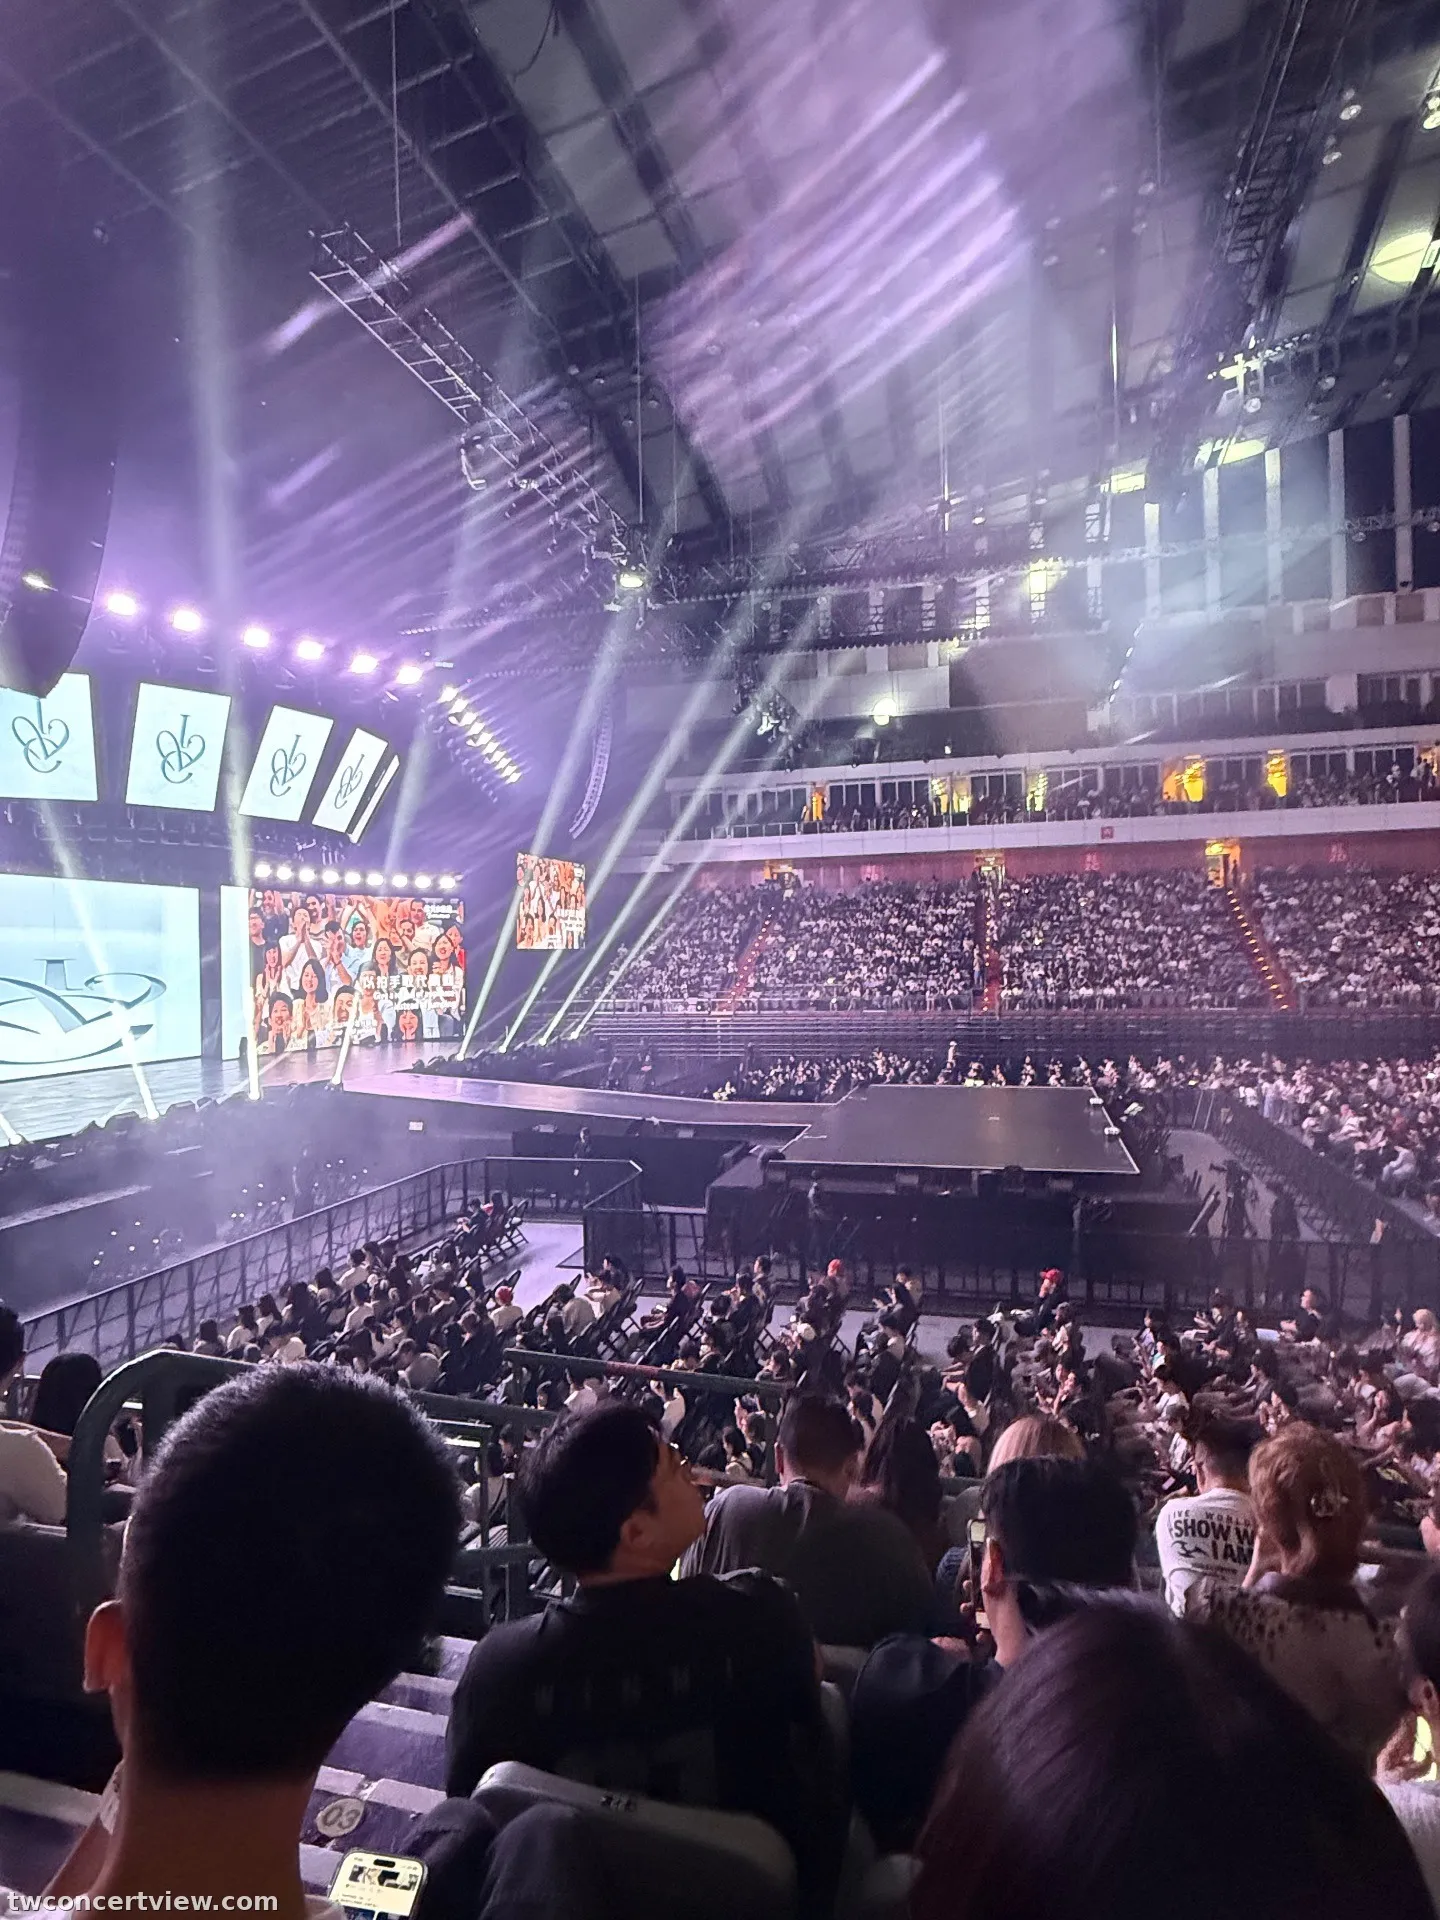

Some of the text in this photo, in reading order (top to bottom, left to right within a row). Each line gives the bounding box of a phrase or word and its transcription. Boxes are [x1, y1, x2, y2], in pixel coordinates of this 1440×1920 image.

[1173, 1518, 1231, 1542] SHOW
[1211, 1540, 1219, 1560] I
[321, 1806, 361, 1830] 03
